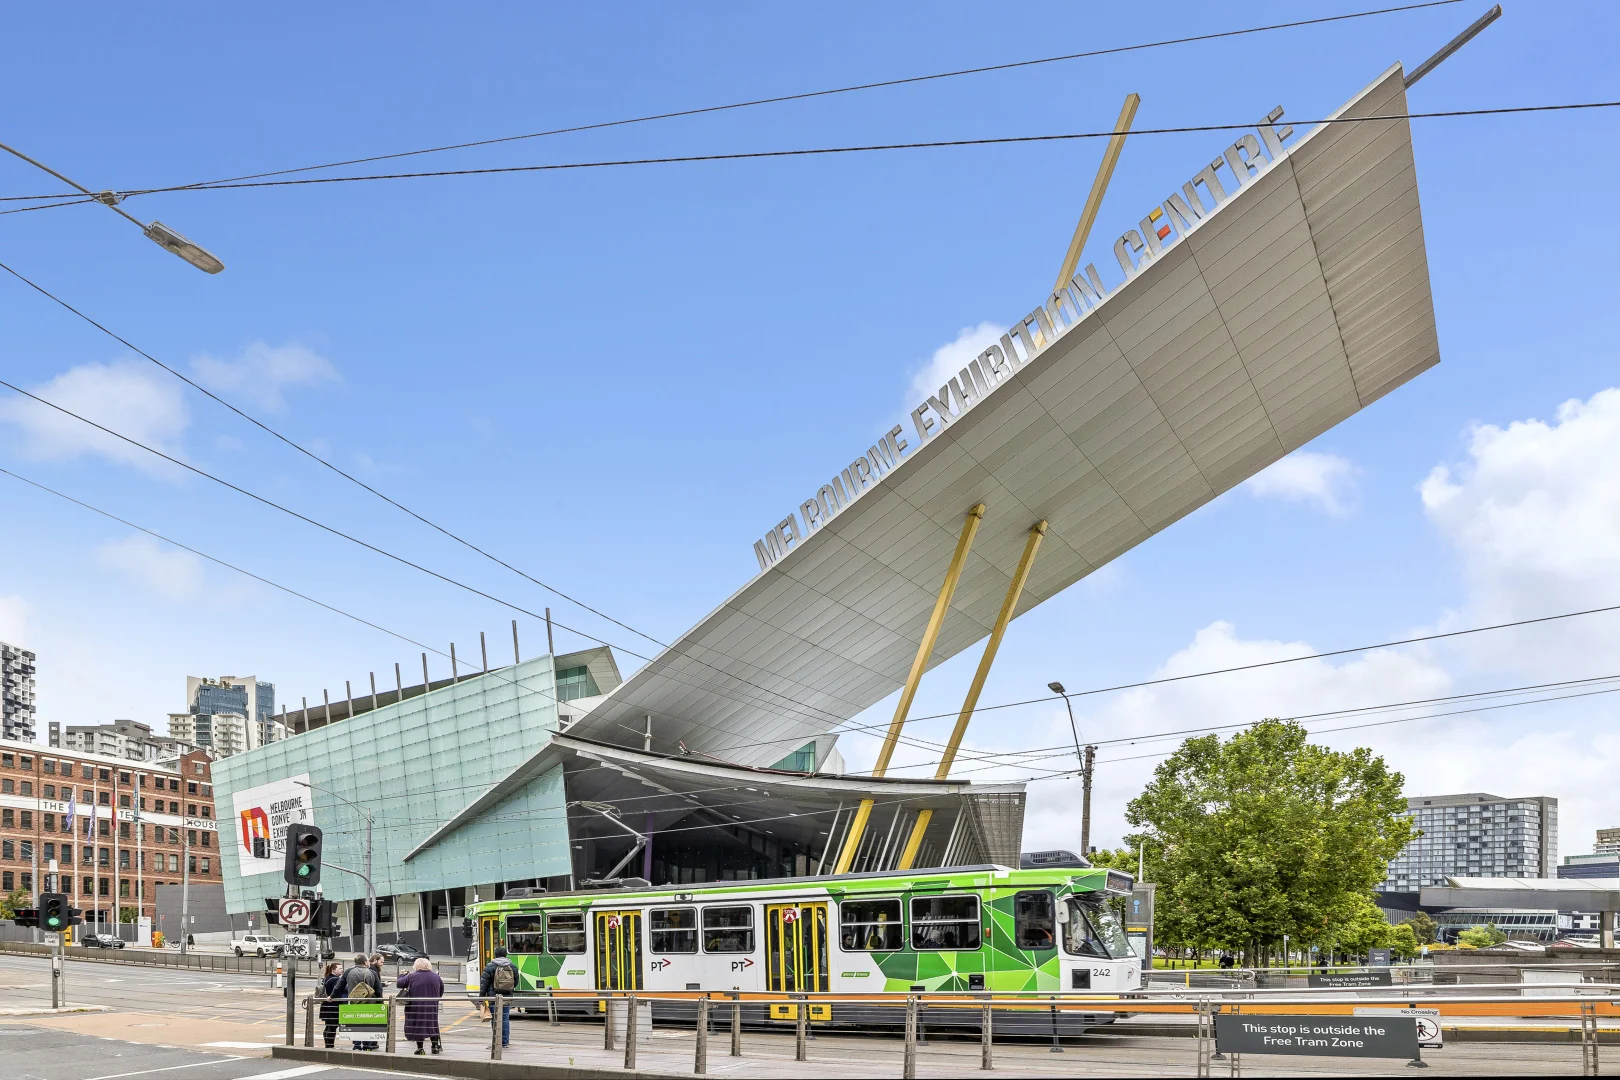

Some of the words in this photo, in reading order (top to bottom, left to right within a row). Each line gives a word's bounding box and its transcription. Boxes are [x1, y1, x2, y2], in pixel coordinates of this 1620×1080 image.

[753, 424, 908, 571] MELBOURNE
[911, 263, 1107, 442] EXHIBITION
[1113, 105, 1294, 278] CENTRE
[43, 801, 64, 811] THE
[270, 797, 302, 814] MELBOURNE
[1093, 968, 1111, 977] 242
[1242, 1023, 1267, 1034] This
[1270, 1025, 1296, 1036] stop
[1300, 1024, 1310, 1034] is
[1313, 1025, 1360, 1036] outside
[1363, 1026, 1386, 1036] the
[1263, 1036, 1292, 1046] Free
[1294, 1037, 1328, 1047] Tram
[1331, 1037, 1364, 1048] Zone
